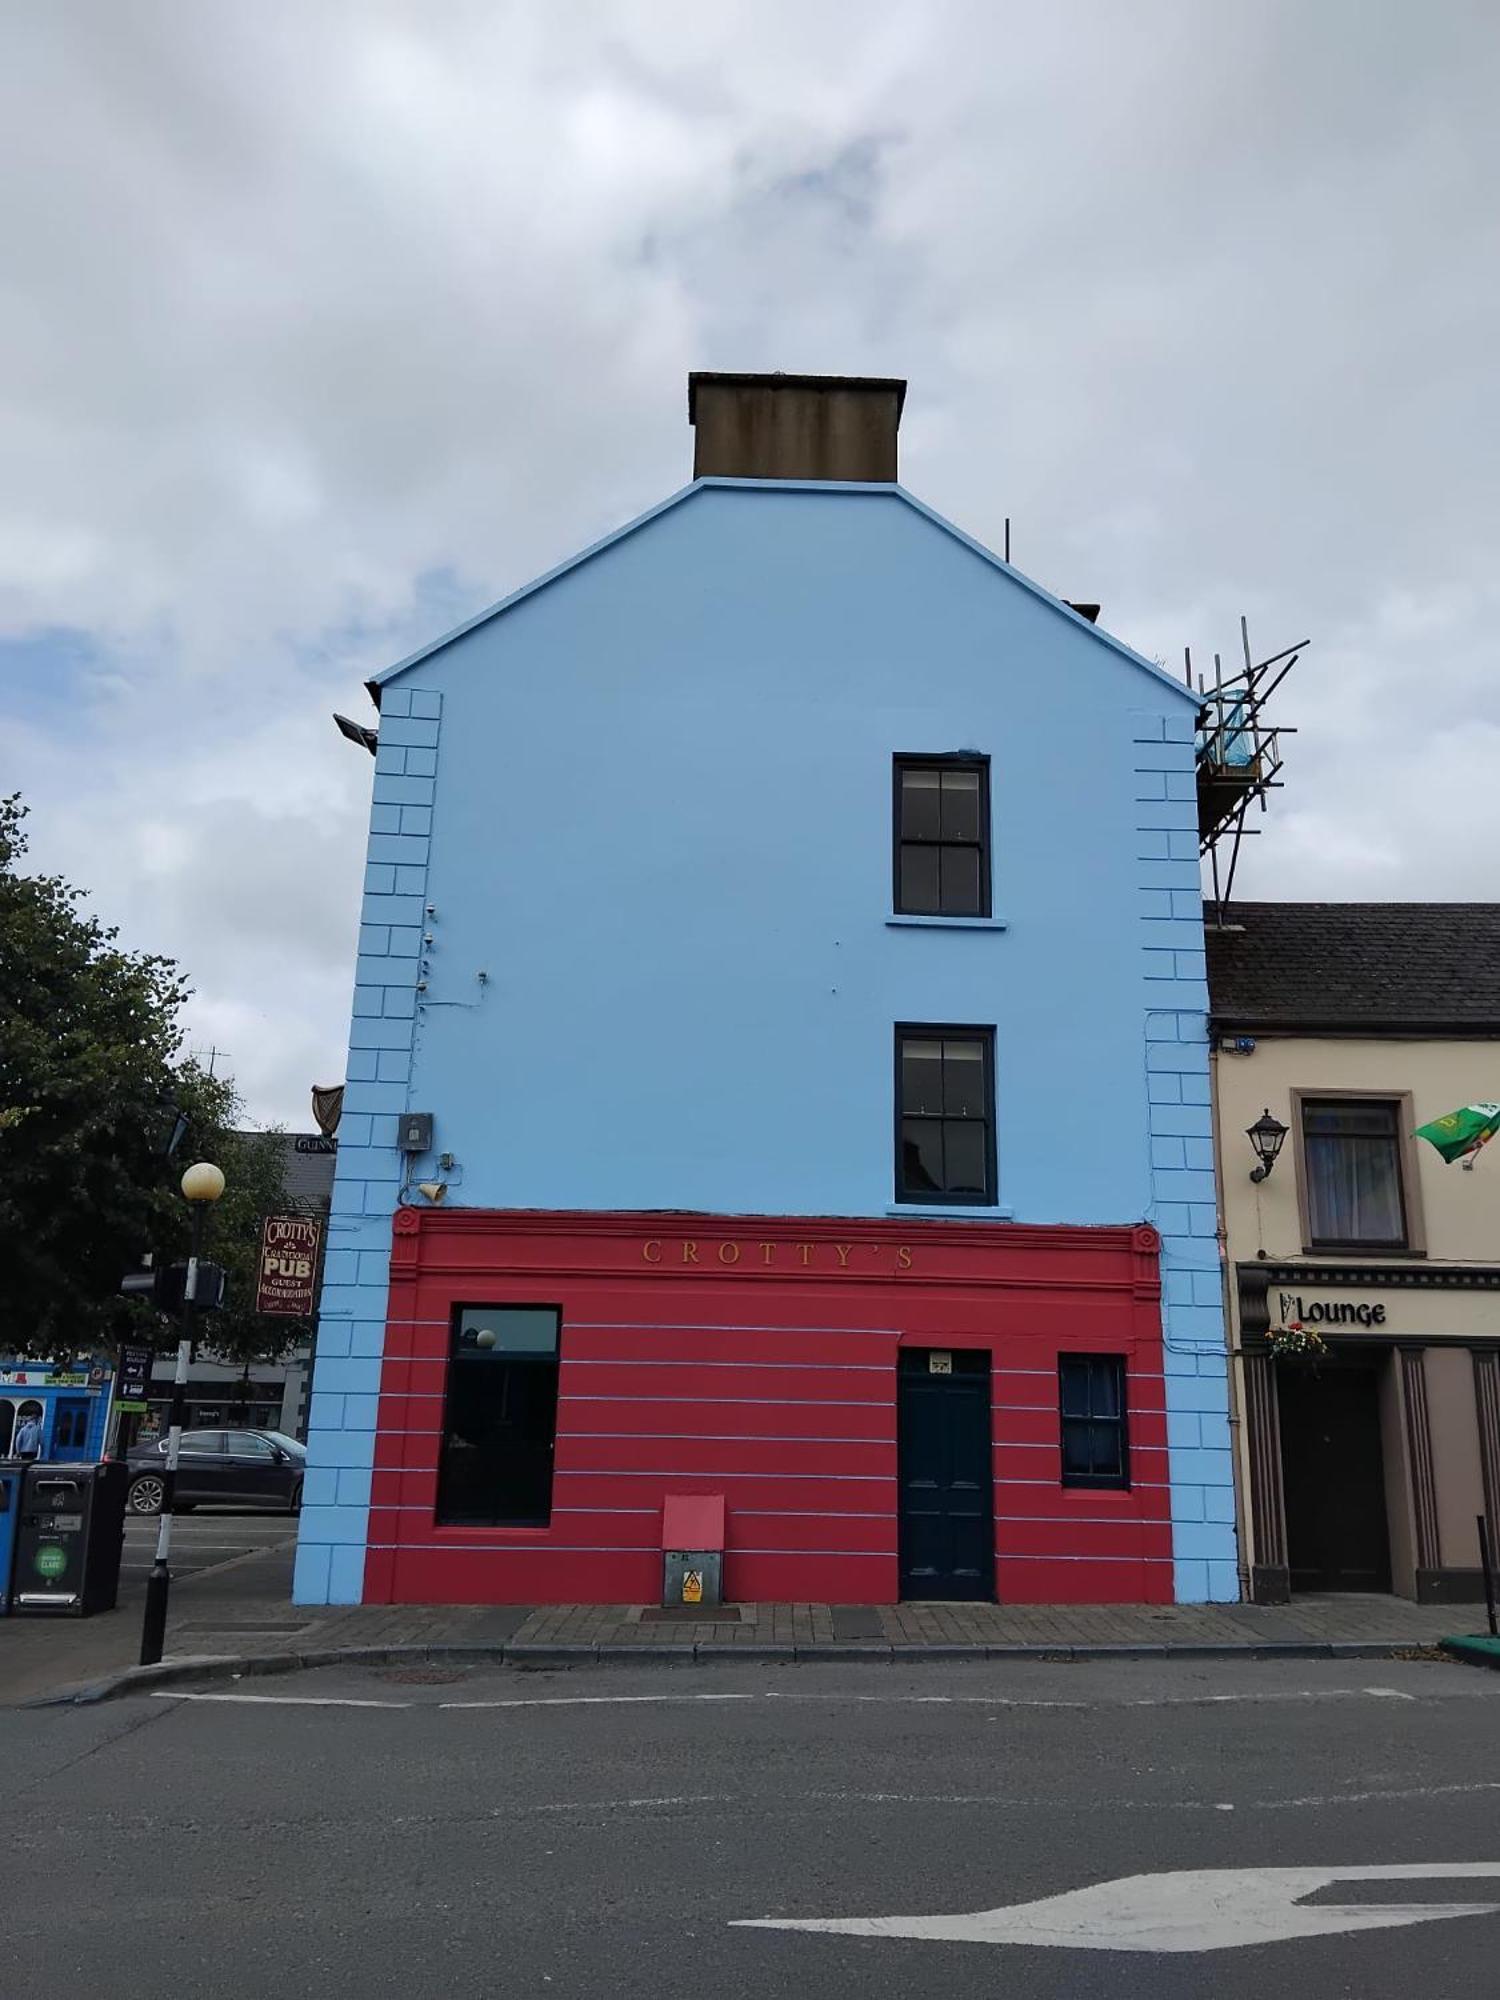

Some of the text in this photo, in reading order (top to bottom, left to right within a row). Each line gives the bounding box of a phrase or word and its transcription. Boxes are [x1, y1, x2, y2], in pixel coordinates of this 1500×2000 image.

[267, 1222, 317, 1248] CROTTY'S
[641, 1239, 913, 1269] CROTTY'S
[264, 1258, 311, 1278] PUB
[271, 1278, 303, 1287] GUEST
